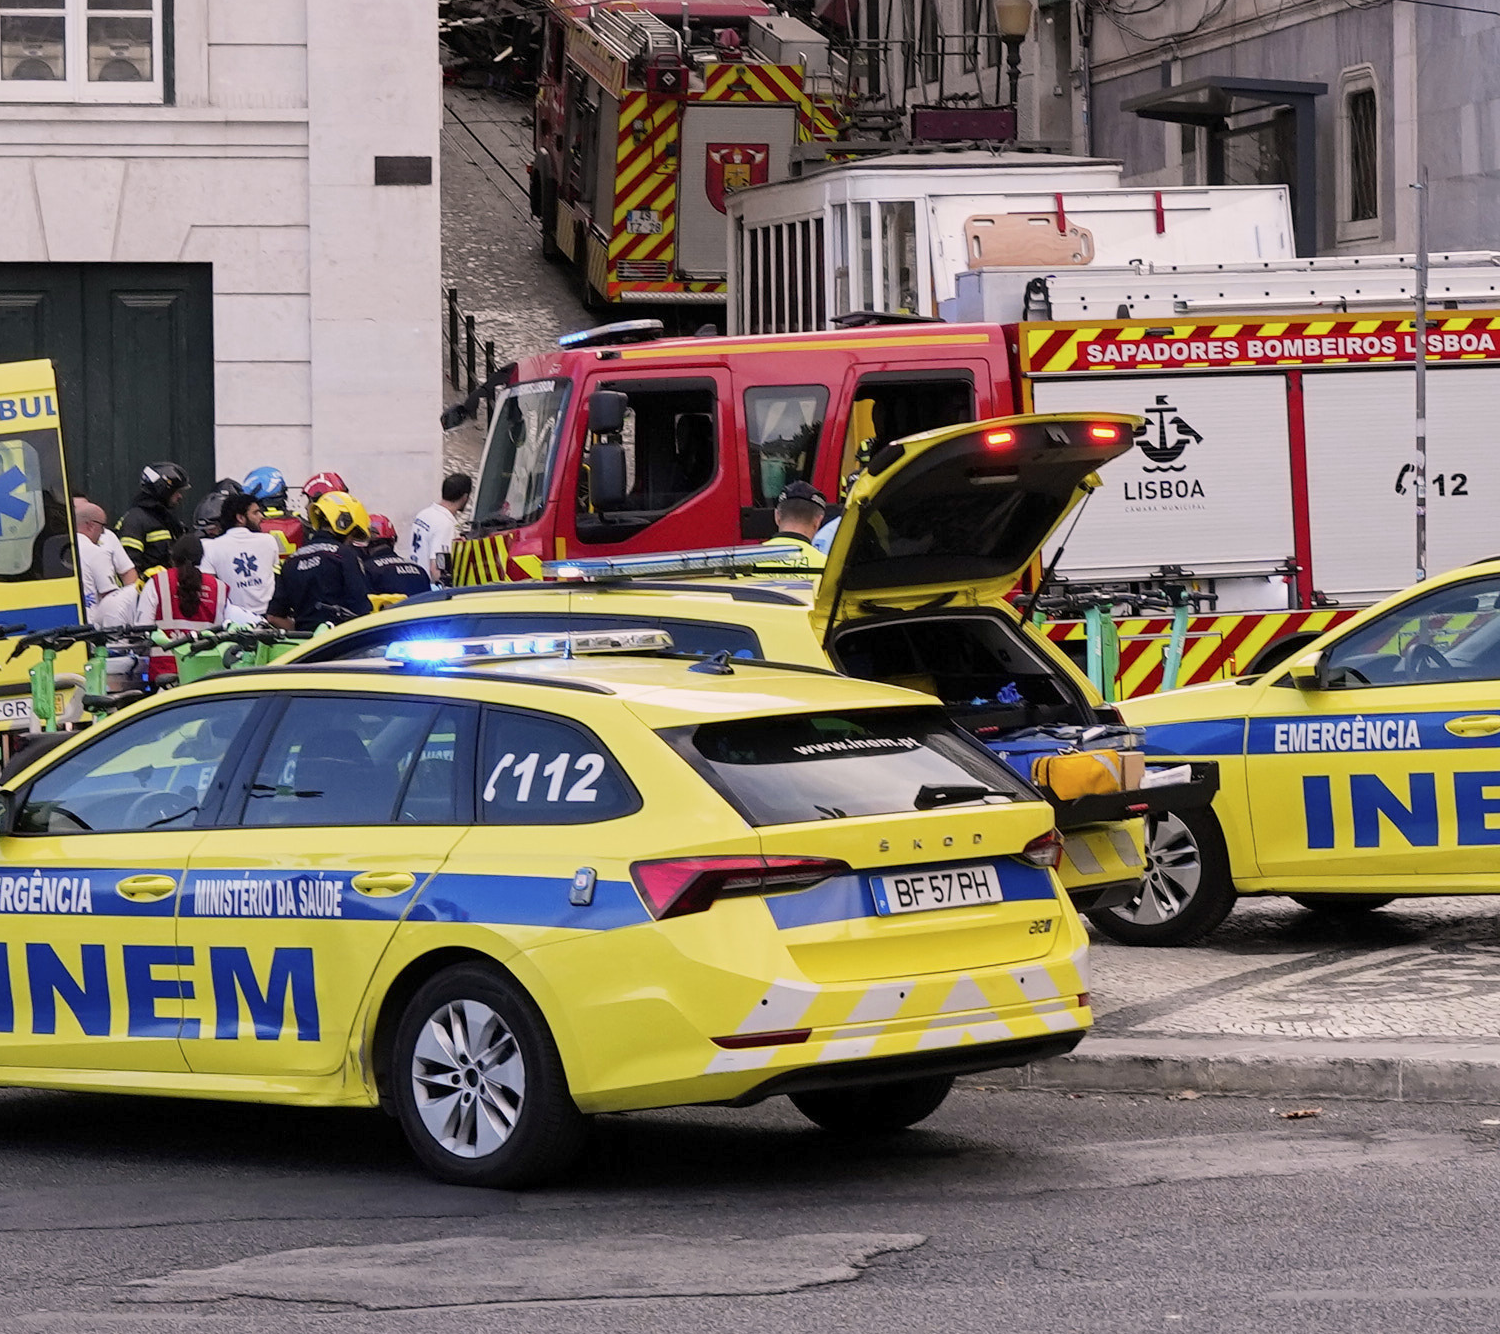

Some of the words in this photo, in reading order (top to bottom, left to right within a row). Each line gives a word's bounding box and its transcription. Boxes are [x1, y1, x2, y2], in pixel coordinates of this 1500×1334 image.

[1086, 339, 1239, 363] SAPADORES
[1247, 334, 1397, 359] BOMBEIROS
[1404, 331, 1496, 354] LSBOA
[1123, 478, 1205, 502] LISBOA
[1414, 473, 1468, 498] 12
[236, 577, 262, 588] INEM
[1274, 715, 1421, 753] EMERGÊNCIA
[512, 752, 605, 803] 112
[194, 871, 273, 916] MINISTÉRIO
[276, 880, 297, 916] DA
[298, 872, 344, 917] SAÚDE
[895, 877, 926, 908] BF
[931, 873, 954, 904] 57
[958, 869, 992, 901] PH
